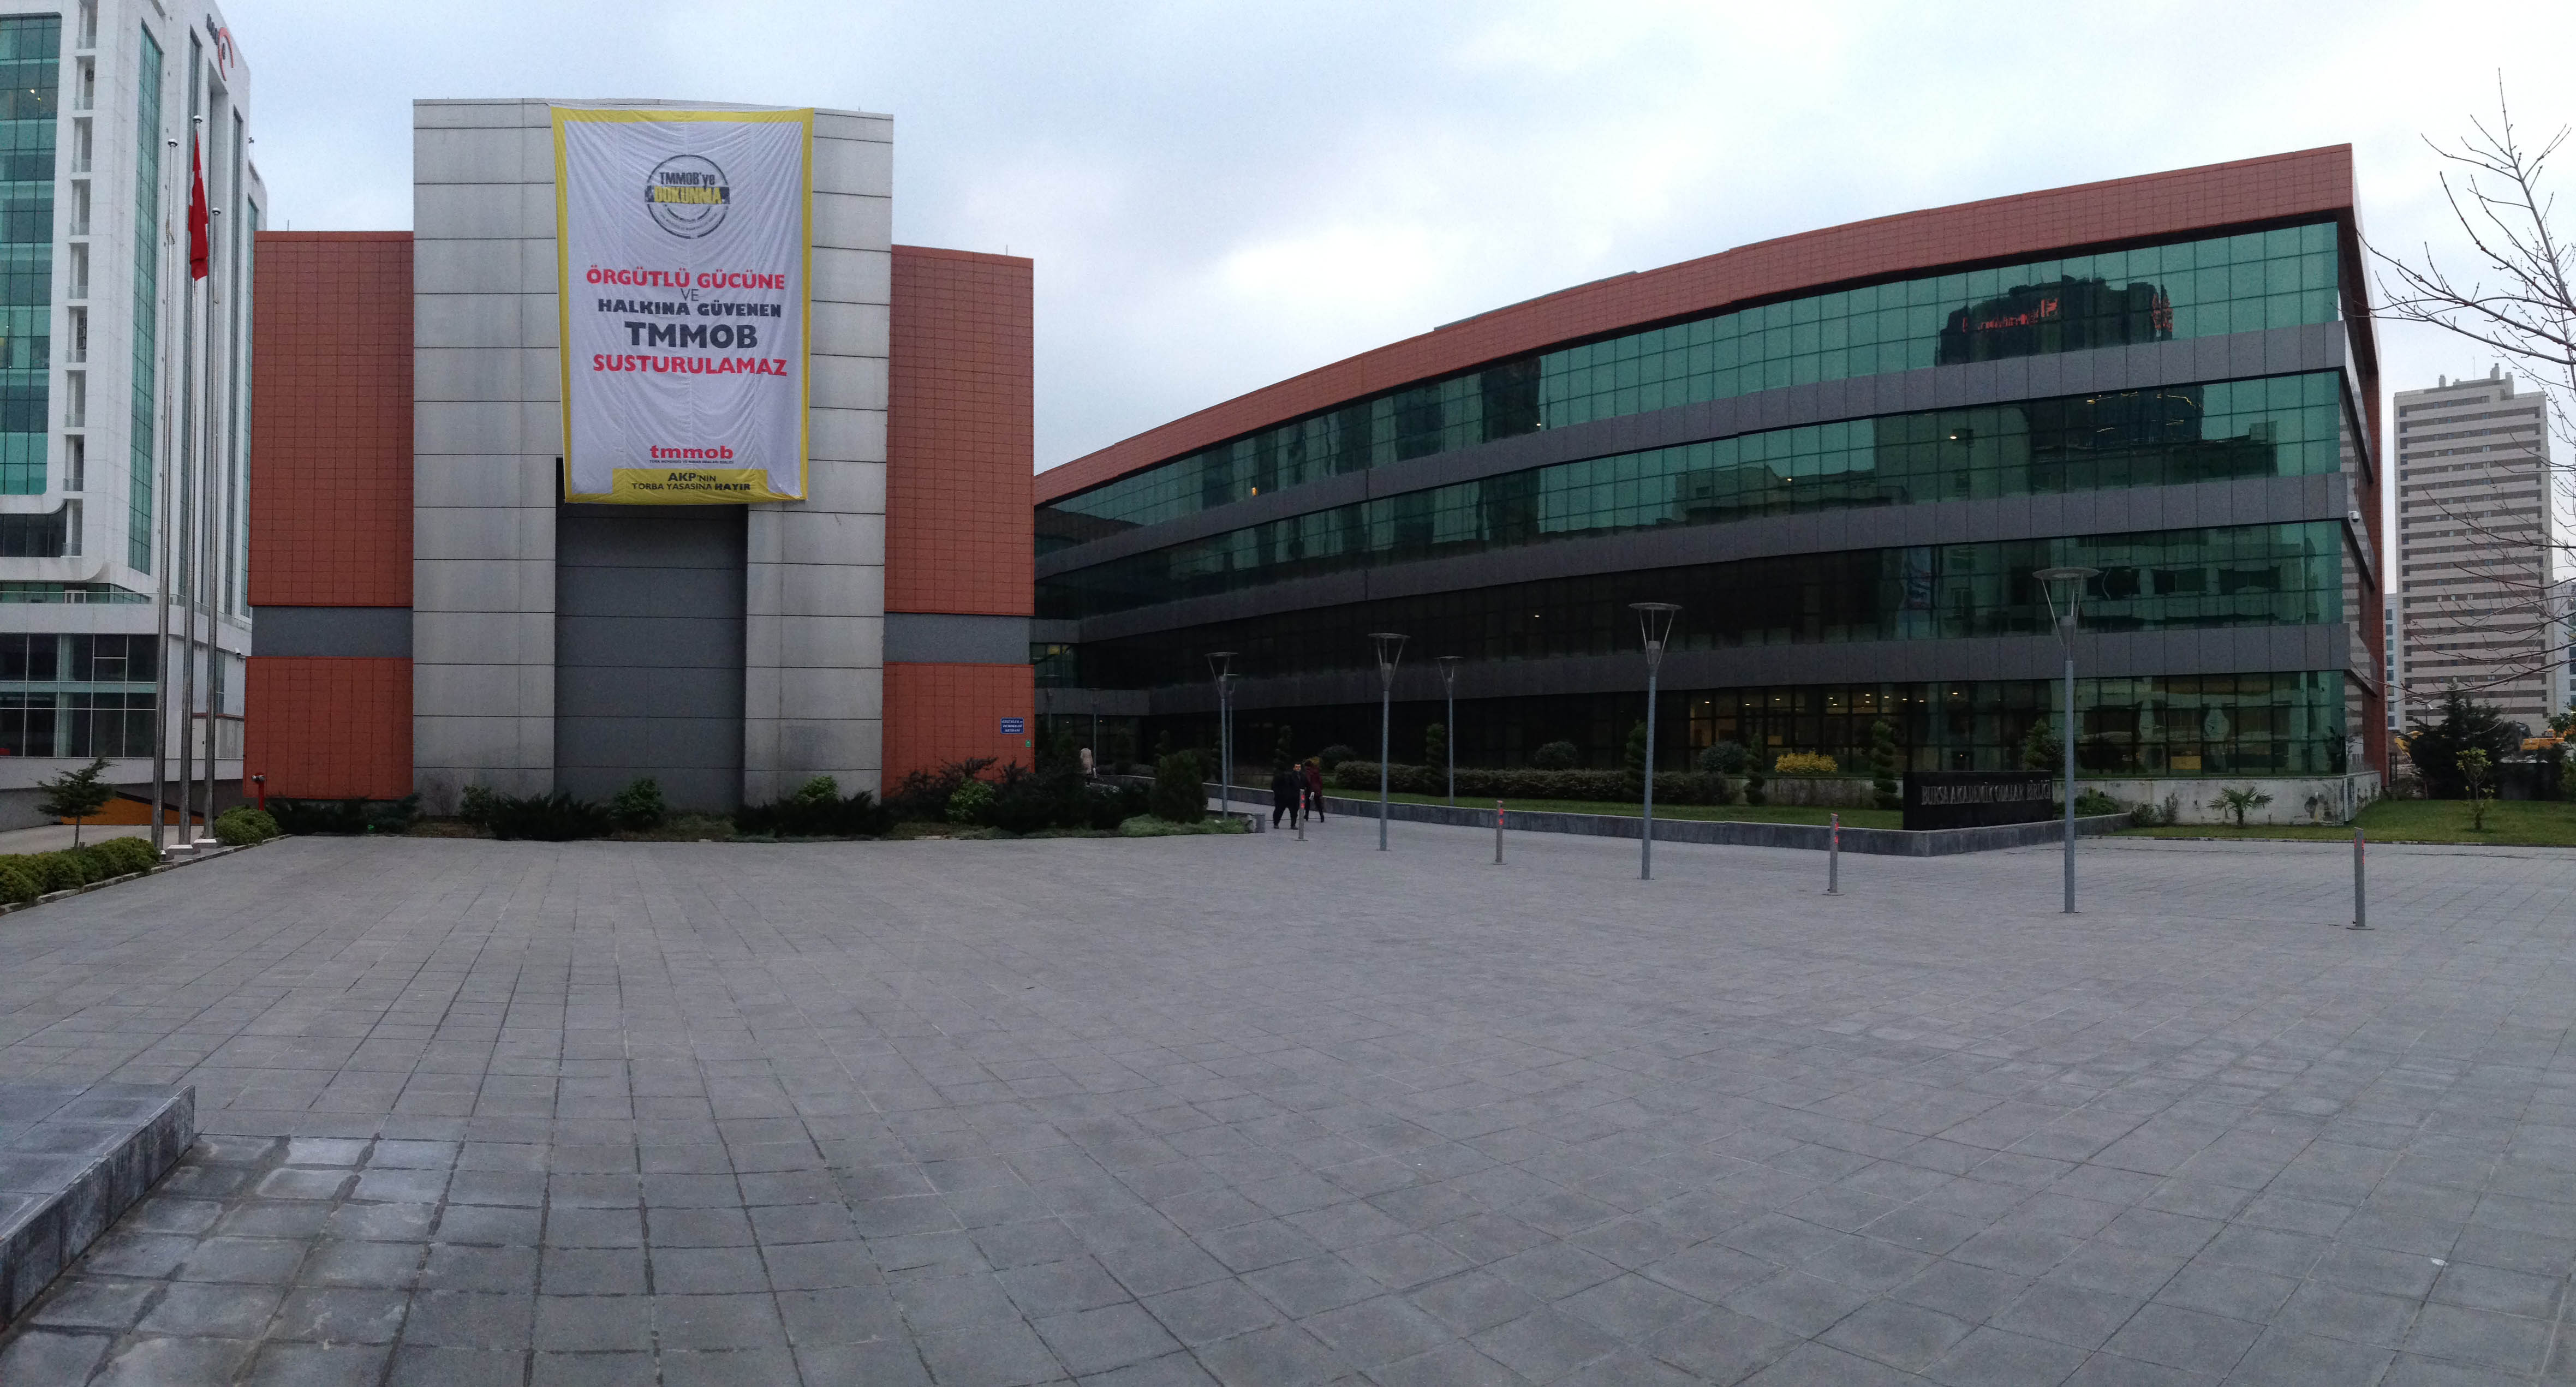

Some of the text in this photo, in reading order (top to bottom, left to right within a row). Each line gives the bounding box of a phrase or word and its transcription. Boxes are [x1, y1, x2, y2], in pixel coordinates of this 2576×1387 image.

[659, 172, 715, 192] TMMOB'ye
[654, 186, 723, 205] DOKUNMA
[586, 264, 785, 290] ÖRGÜTLÜ GÜCÜNE
[680, 288, 699, 302] VE
[598, 298, 782, 318] HALKINA GÜVENEN
[624, 321, 758, 349] TMMOB
[593, 354, 788, 376] SUSTURULAMAZ
[650, 445, 734, 459] tmmob
